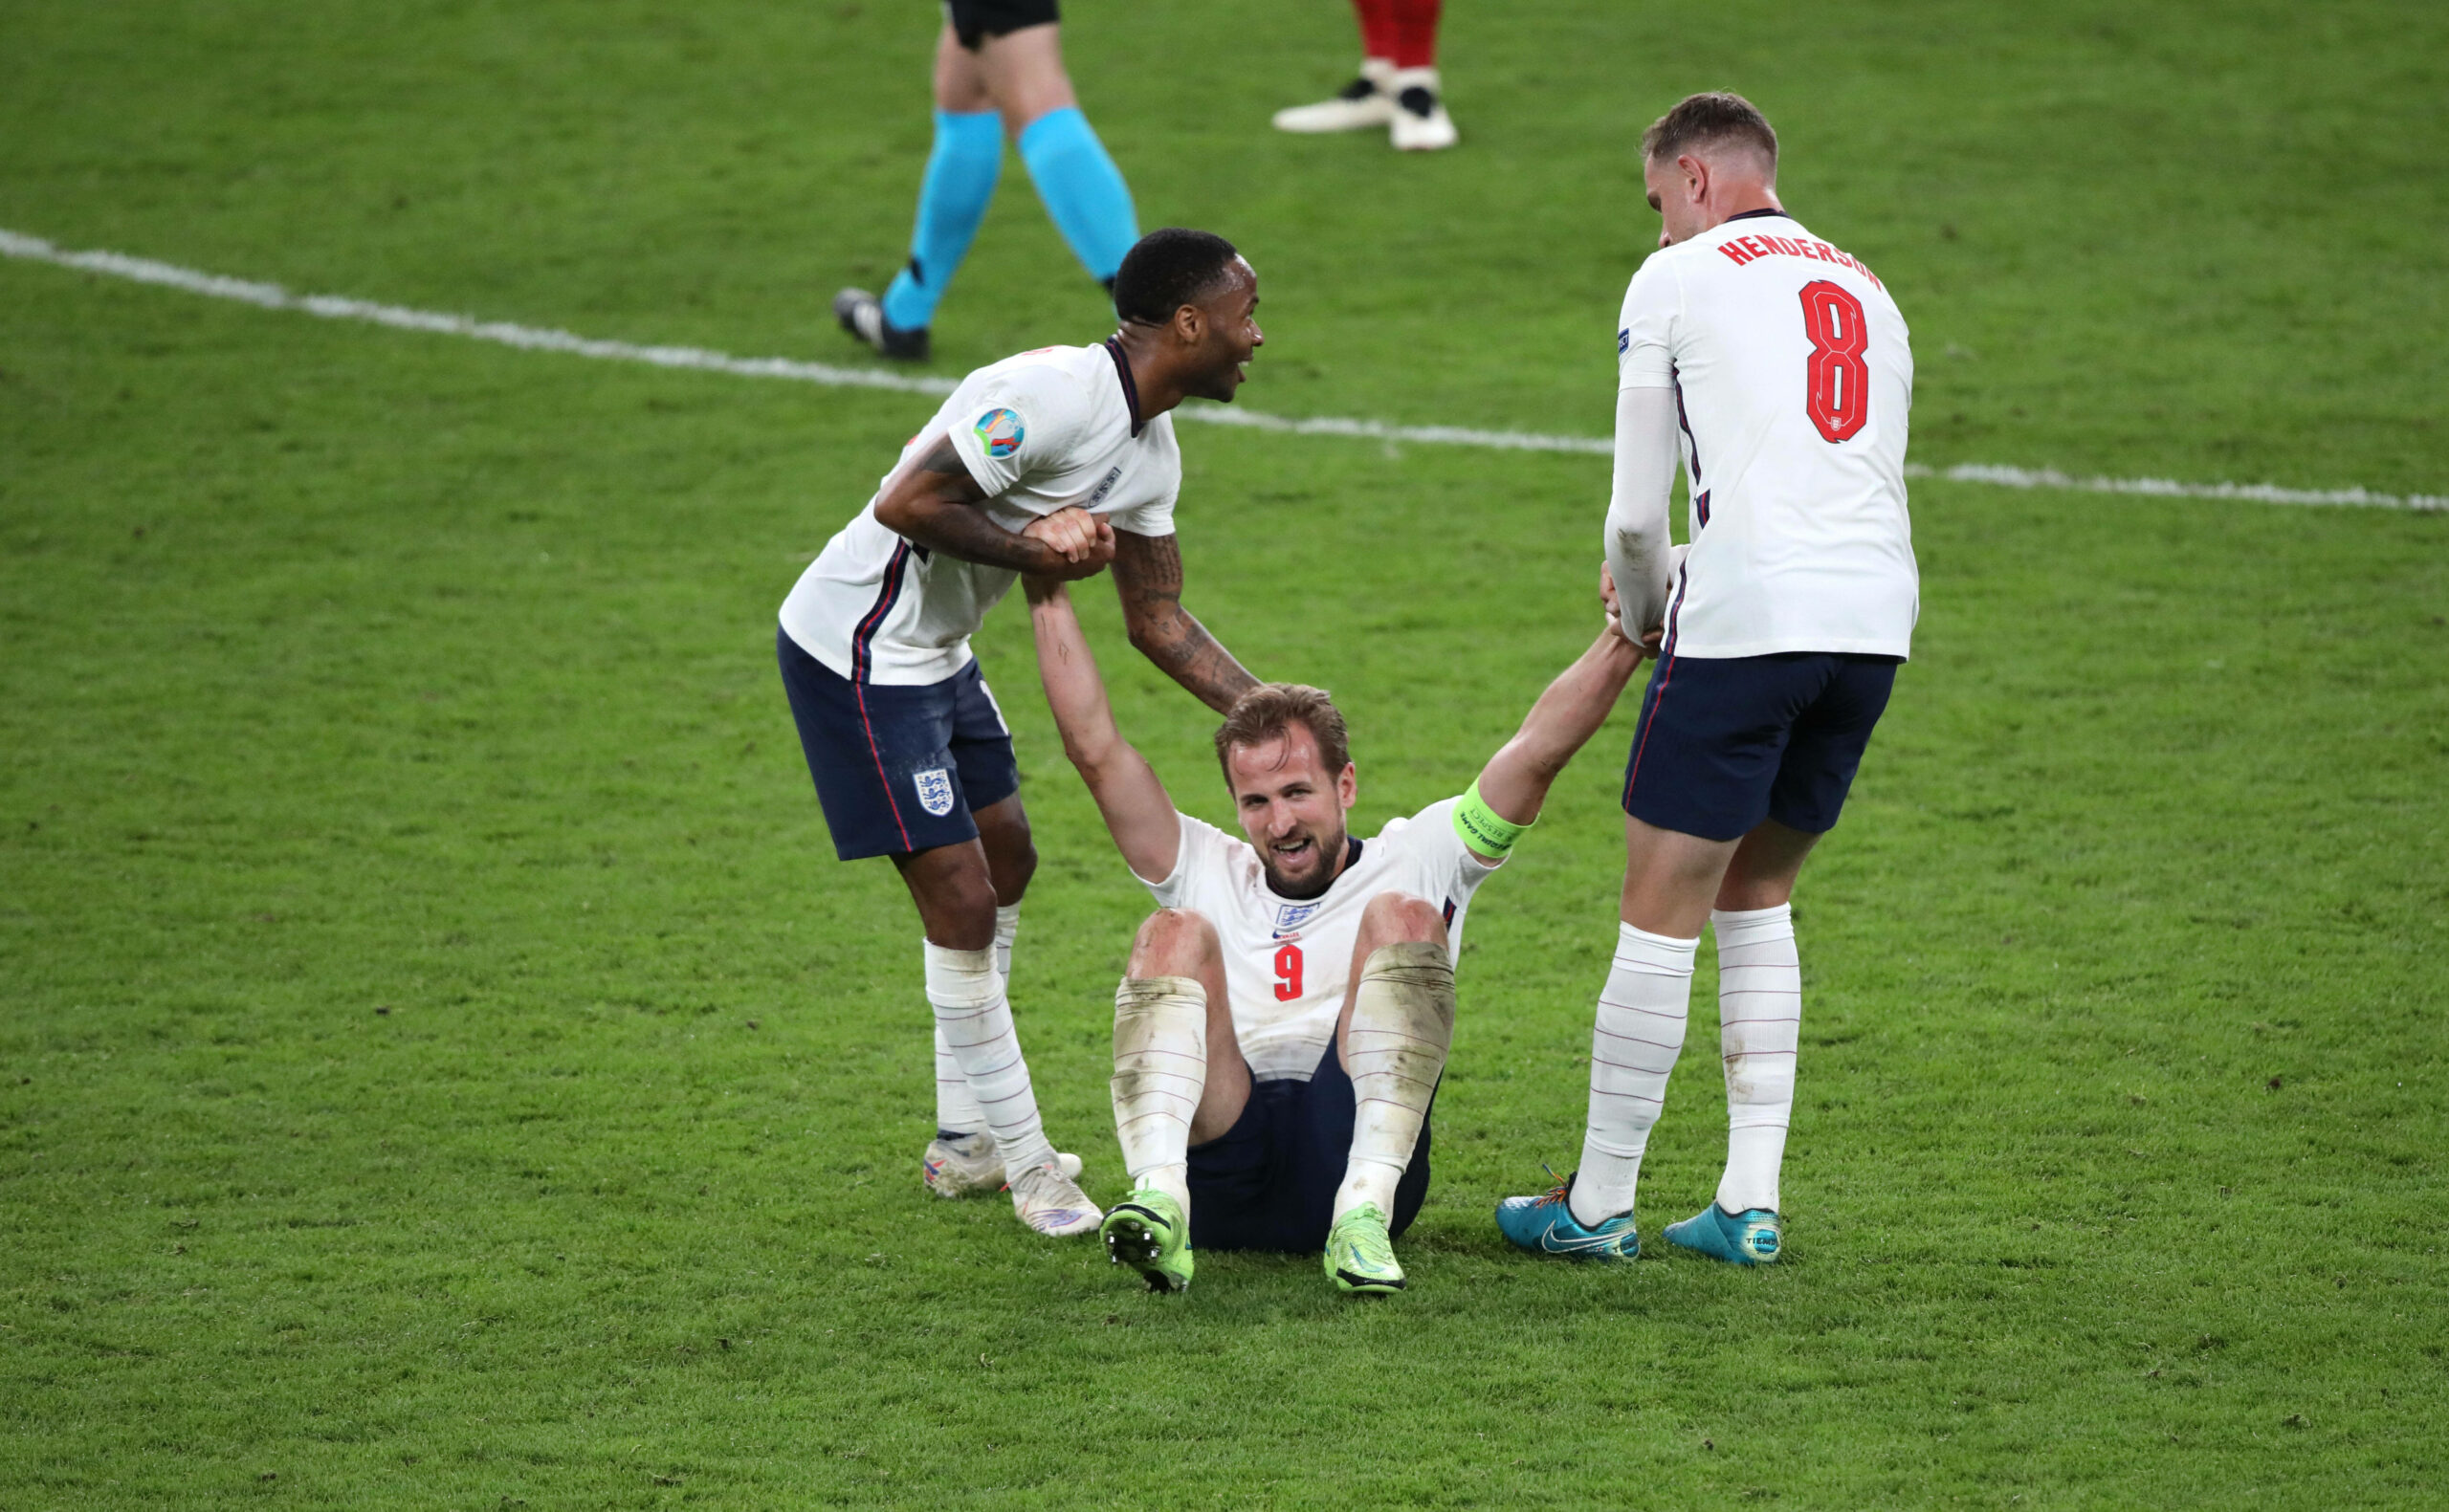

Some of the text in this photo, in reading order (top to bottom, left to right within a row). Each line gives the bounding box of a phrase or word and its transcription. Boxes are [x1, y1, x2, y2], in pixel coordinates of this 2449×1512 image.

[1718, 235, 1883, 292] HENDERSON
[1798, 279, 1868, 444] 8
[1460, 811, 1478, 834] GAME
[1470, 808, 1504, 838] RESPECT
[1274, 944, 1303, 1001] 9
